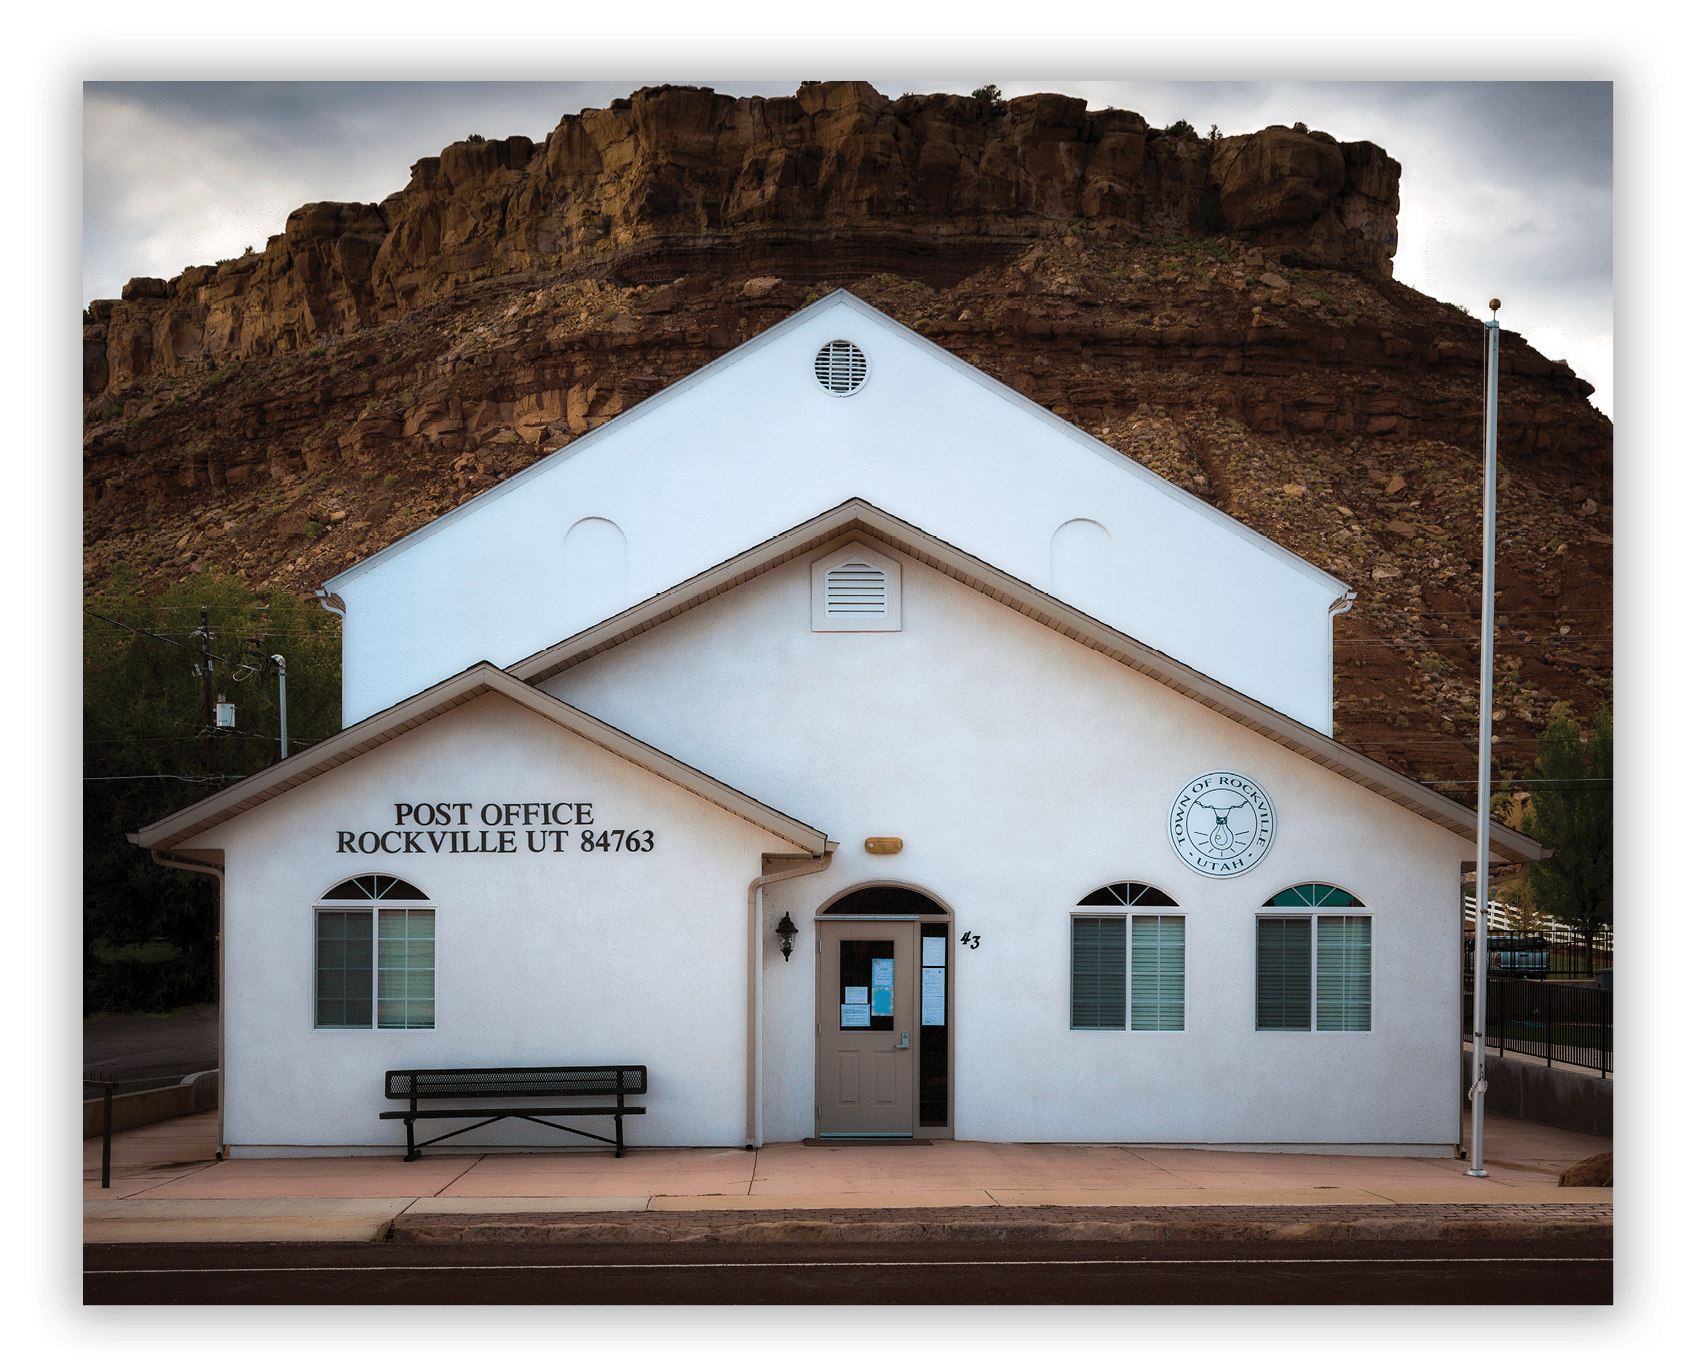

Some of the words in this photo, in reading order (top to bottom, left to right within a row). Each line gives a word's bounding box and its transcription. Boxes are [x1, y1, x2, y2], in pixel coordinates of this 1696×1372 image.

[394, 802, 472, 826] POST
[481, 802, 594, 826] OFFICE
[1174, 795, 1191, 847] TOWN
[1192, 778, 1212, 793] OF
[1219, 776, 1269, 847] ROCKVILLE
[336, 830, 517, 854] ROCKVILLE
[525, 830, 569, 853] UT
[580, 829, 655, 853] 84763
[1196, 857, 1245, 872] UTAH
[960, 930, 981, 950] 43
